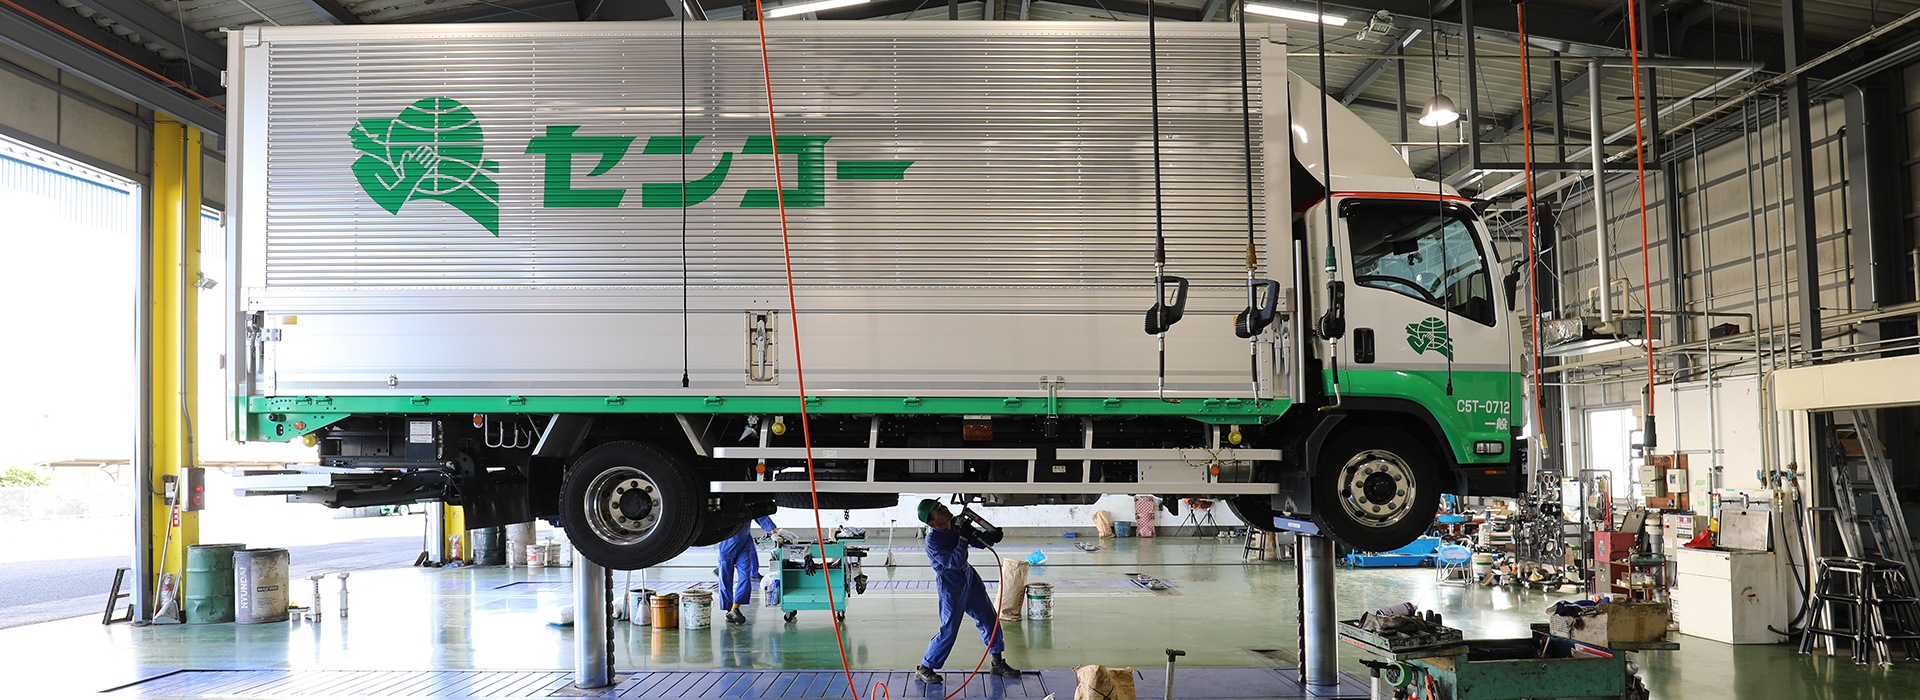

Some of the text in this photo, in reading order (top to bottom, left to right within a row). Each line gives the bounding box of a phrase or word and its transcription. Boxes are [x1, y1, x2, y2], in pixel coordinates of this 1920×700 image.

[525, 125, 917, 208] センコー
[1457, 399, 1510, 414] C5T-0712
[1484, 417, 1508, 430] 一般
[240, 567, 248, 609] HYUNDAI
